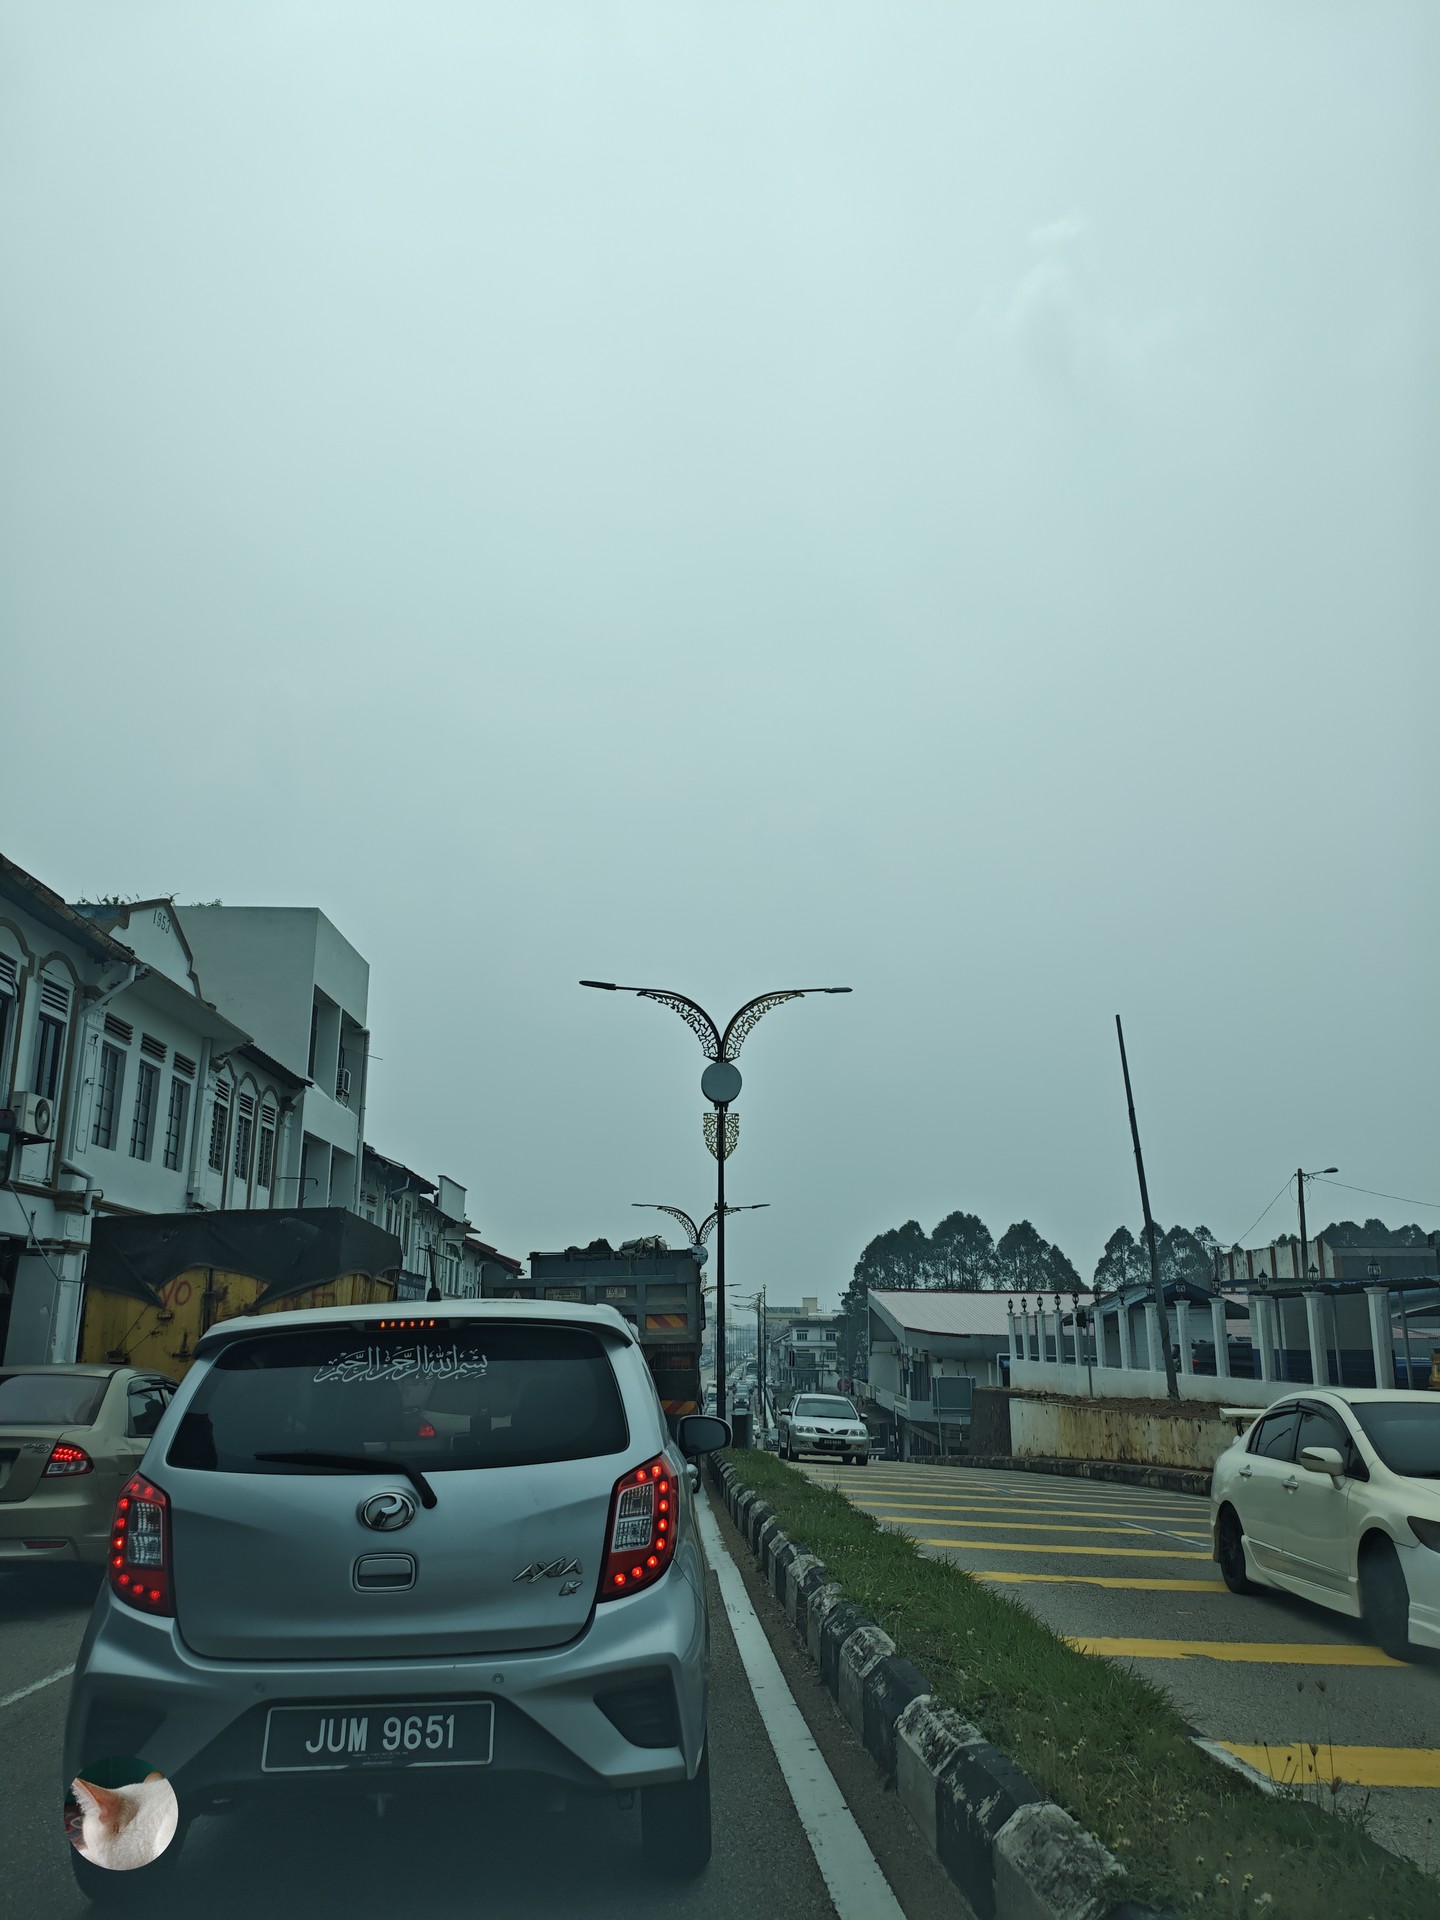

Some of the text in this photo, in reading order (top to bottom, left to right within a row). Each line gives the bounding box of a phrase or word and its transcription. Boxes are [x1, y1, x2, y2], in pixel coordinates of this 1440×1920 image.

[153, 910, 171, 934] 1953
[512, 1556, 583, 1583] AXIA
[305, 1714, 455, 1753] JUM 9651
